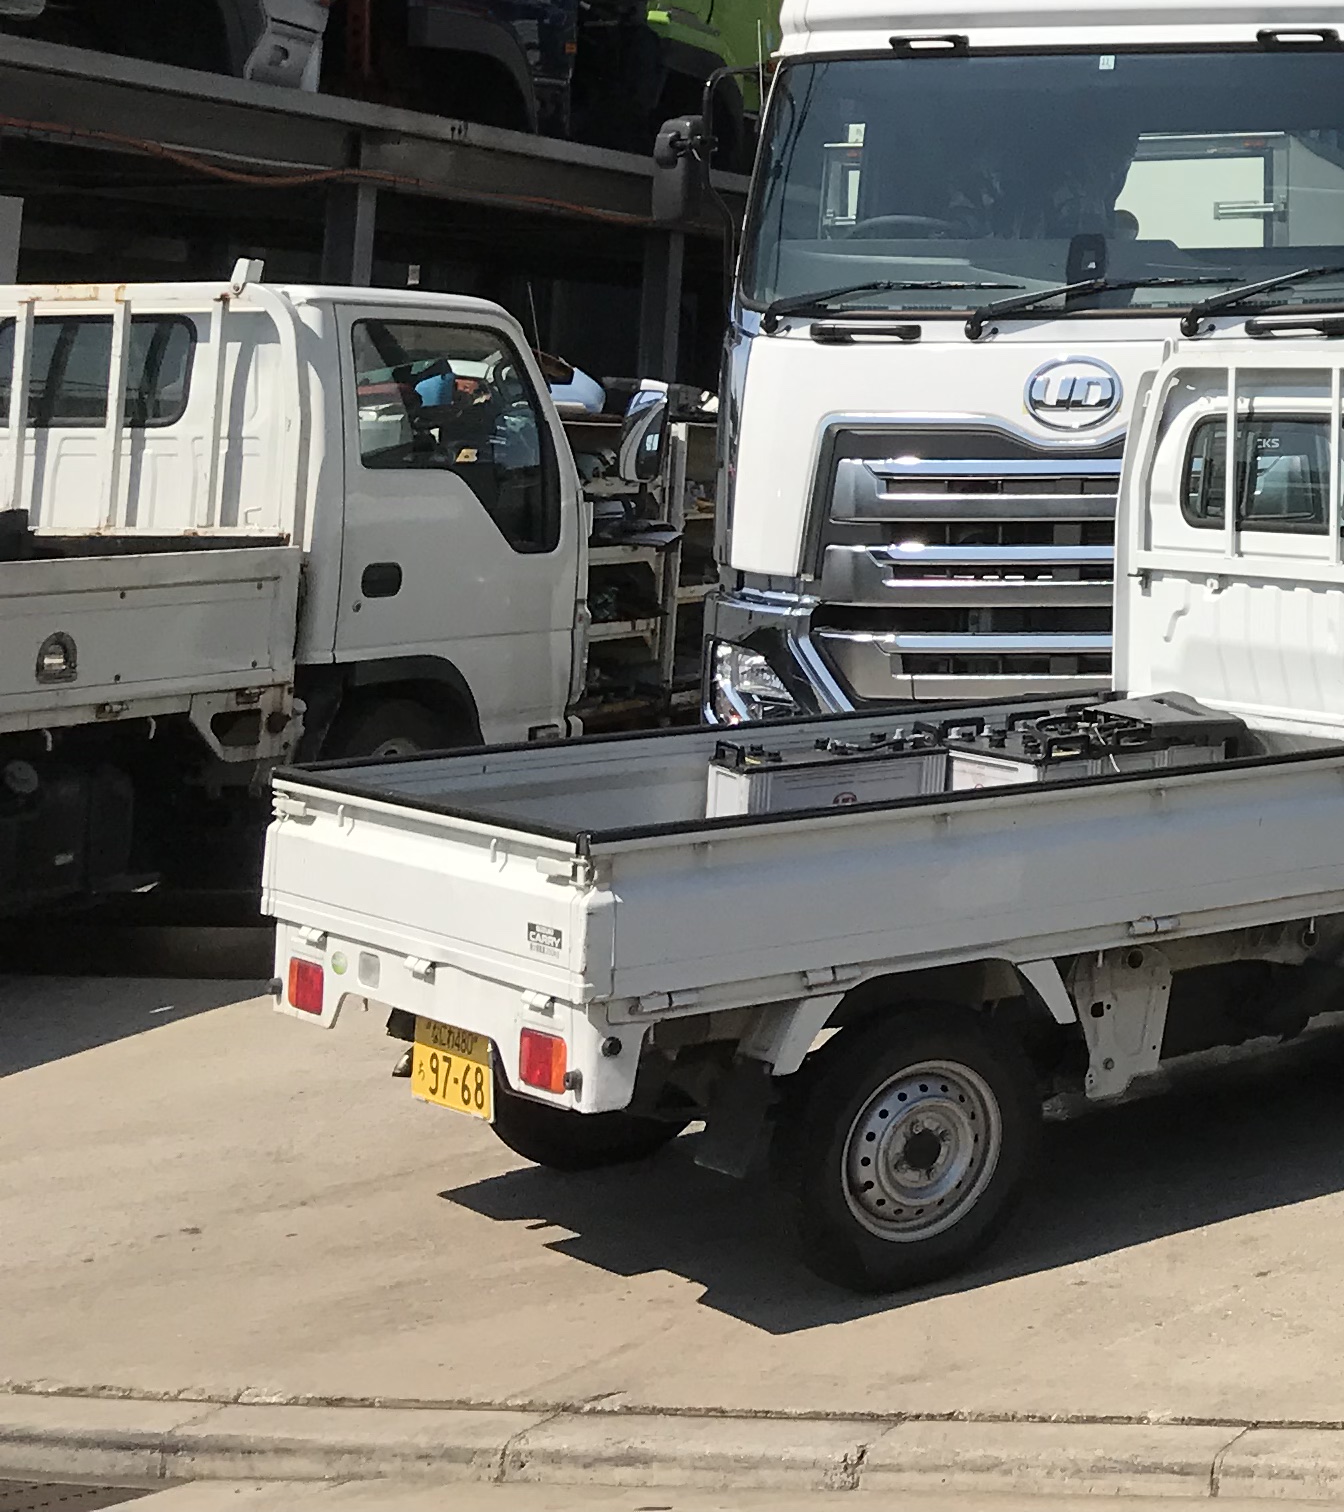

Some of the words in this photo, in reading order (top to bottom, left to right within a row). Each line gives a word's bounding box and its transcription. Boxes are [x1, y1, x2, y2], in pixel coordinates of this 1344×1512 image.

[1029, 376, 1114, 411] UD
[529, 930, 561, 948] CARRY
[428, 1052, 485, 1110] 97-68
